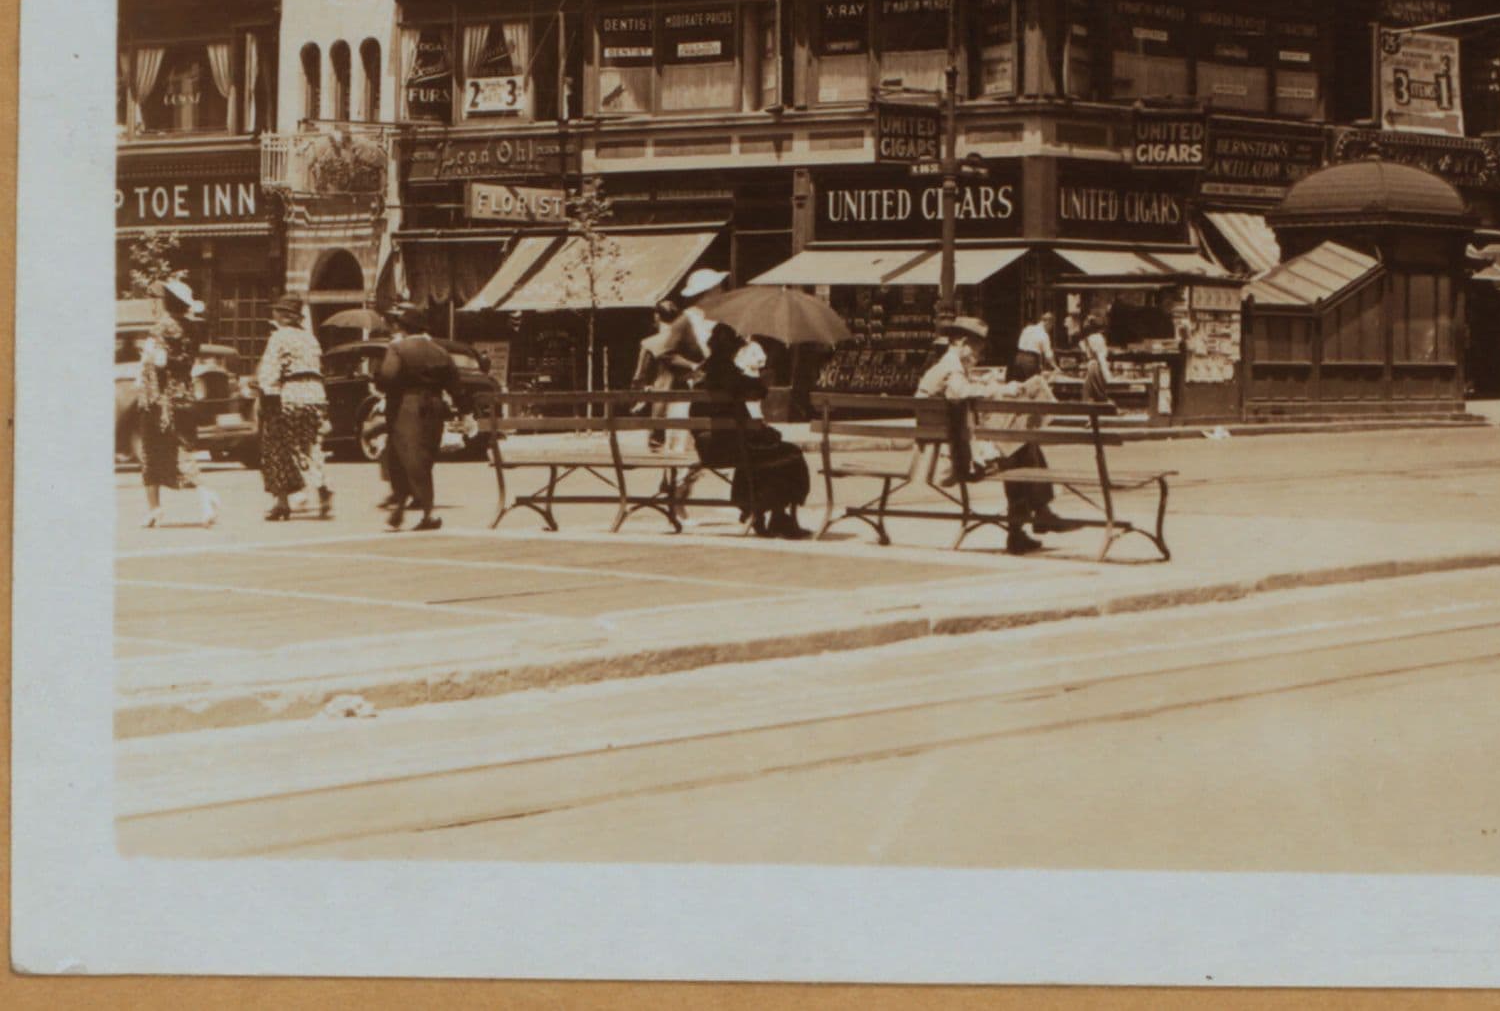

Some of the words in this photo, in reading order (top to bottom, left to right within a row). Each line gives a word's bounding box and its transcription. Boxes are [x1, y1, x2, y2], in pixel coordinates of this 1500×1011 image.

[880, 116, 937, 136] UNITED
[1136, 121, 1203, 141] UNITED
[1135, 143, 1203, 164] CIGARS
[134, 184, 191, 219] TOE
[203, 182, 256, 218] INN
[478, 191, 562, 216] FLORIST
[828, 188, 911, 222] UNITED
[1060, 187, 1118, 222] UNITED
[1124, 190, 1181, 225] CIGARS
